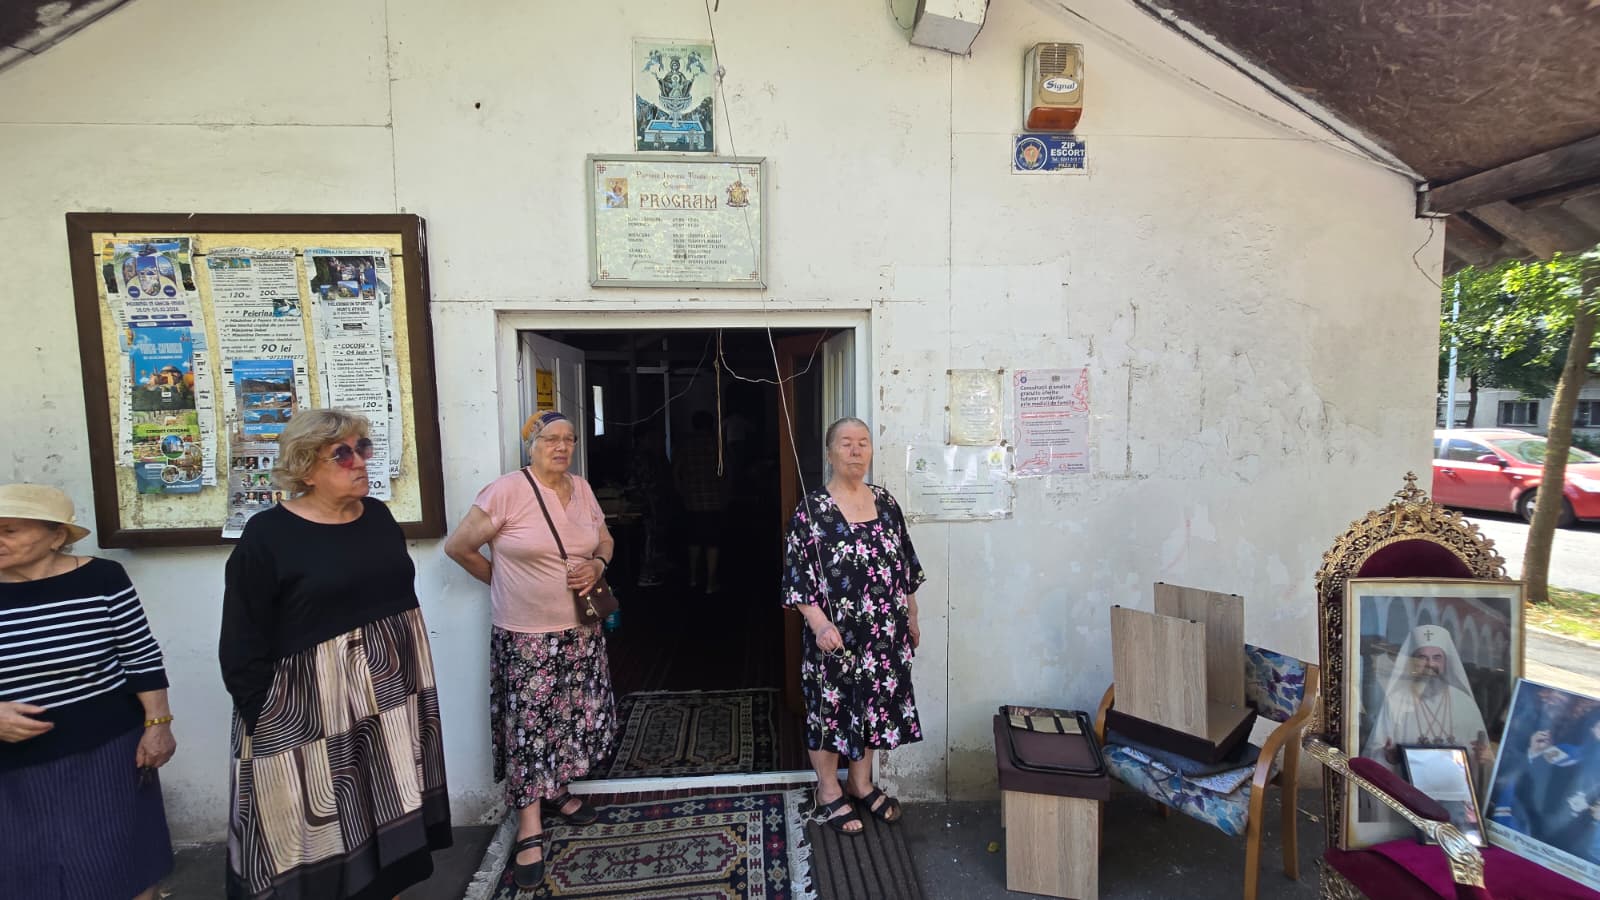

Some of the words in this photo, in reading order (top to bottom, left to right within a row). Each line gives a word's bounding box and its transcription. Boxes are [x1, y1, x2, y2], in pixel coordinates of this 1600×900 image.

[1046, 80, 1075, 91] Signal
[1061, 141, 1076, 149] ZIP
[1050, 149, 1085, 157] ESCORT
[640, 193, 717, 209] PROGRAM
[261, 344, 278, 353] 90
[280, 344, 292, 353] lei
